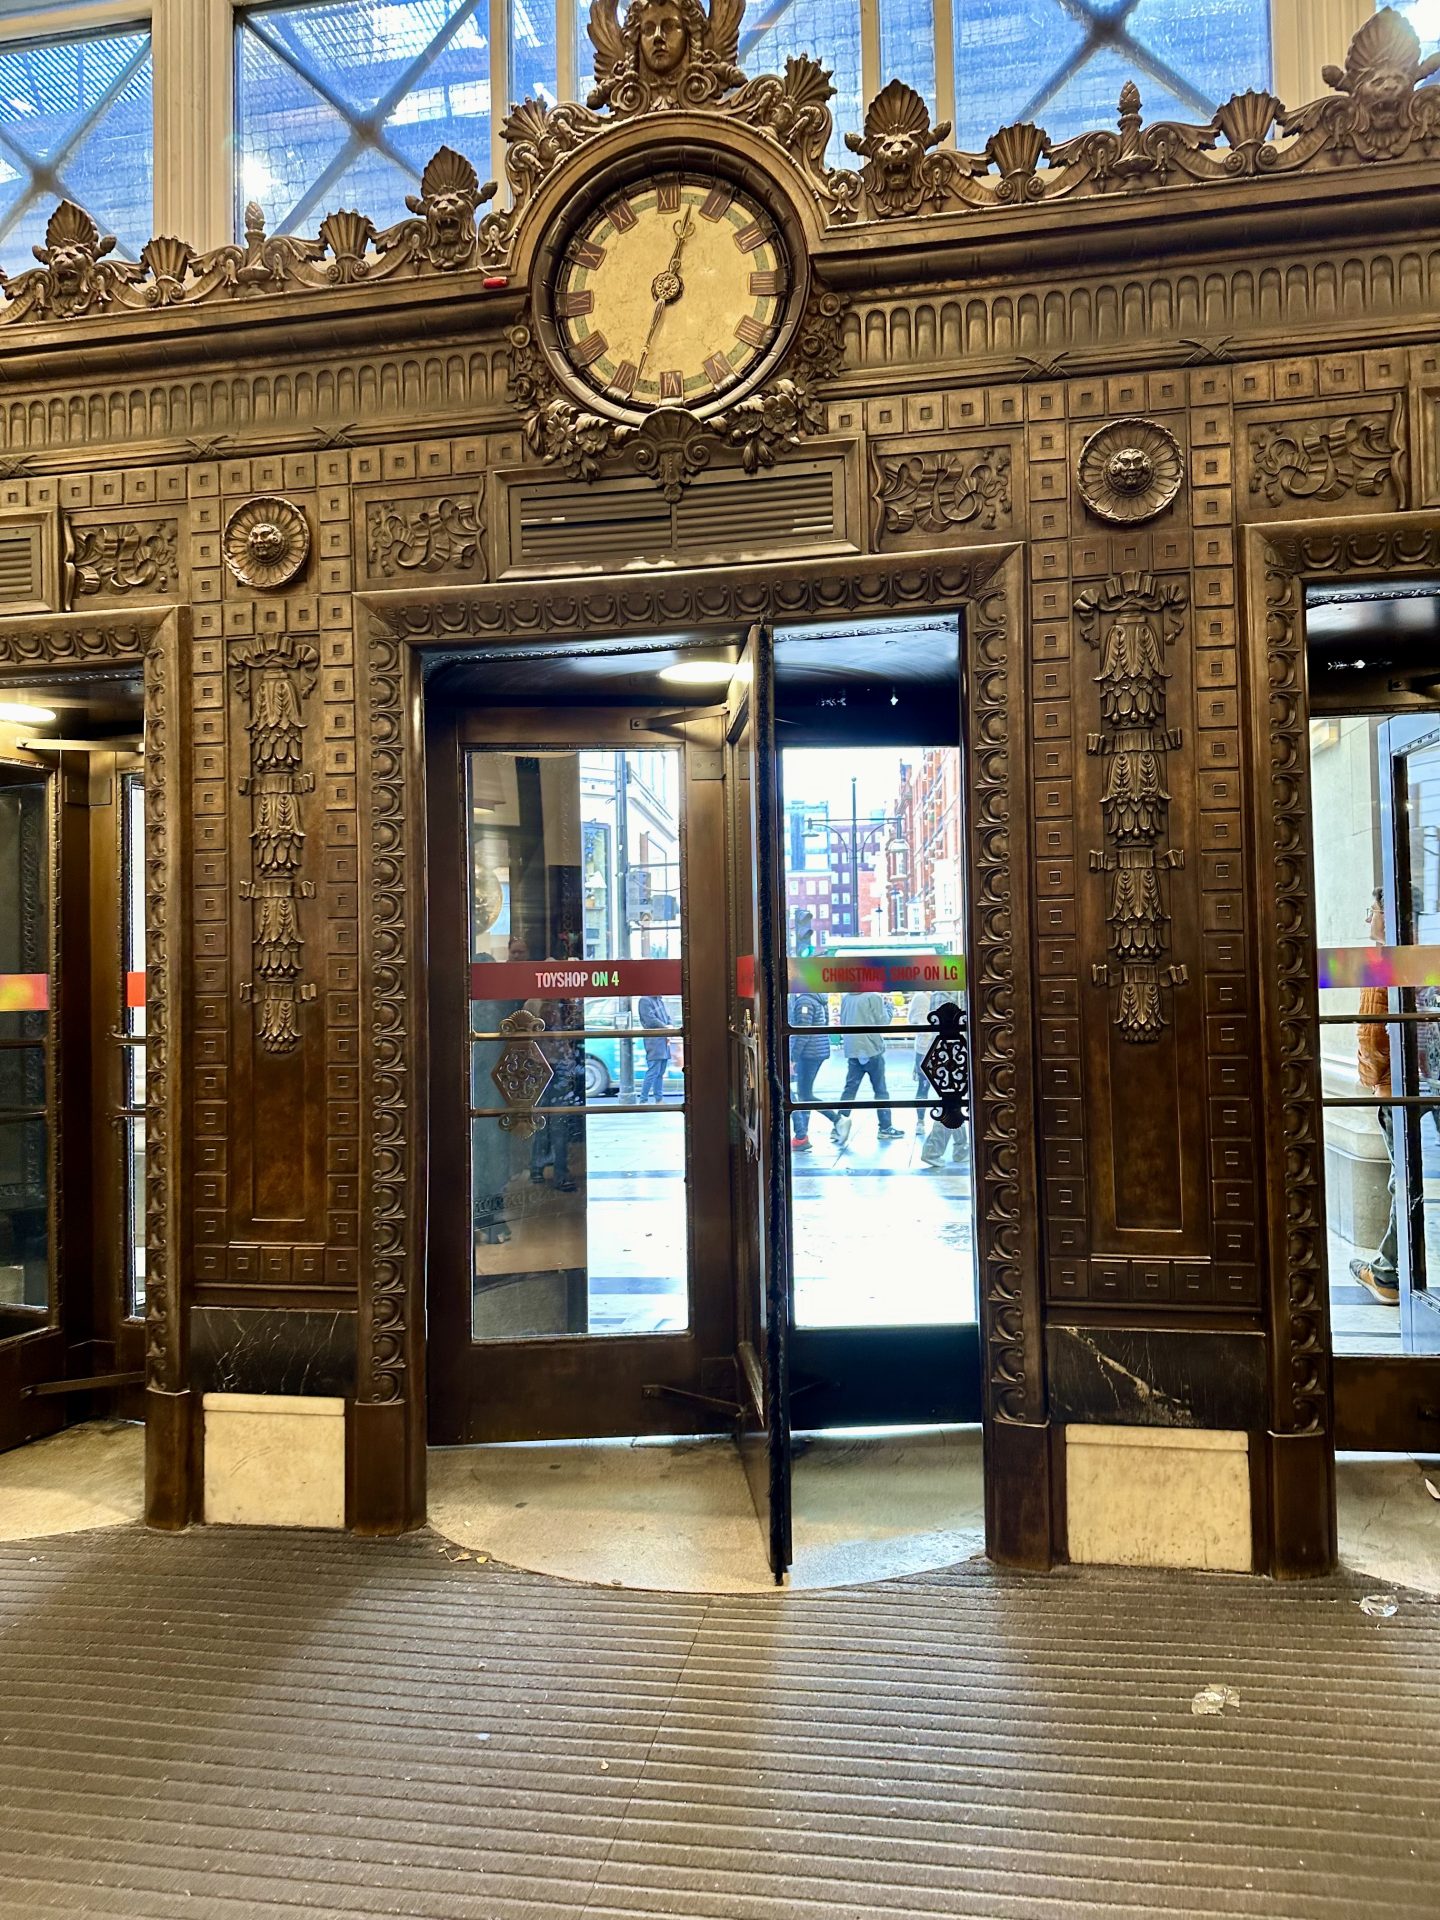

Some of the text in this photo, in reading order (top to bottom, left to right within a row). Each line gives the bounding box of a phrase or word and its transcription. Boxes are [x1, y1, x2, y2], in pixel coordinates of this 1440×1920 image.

[659, 188, 678, 209] XII
[709, 195, 721, 213] I
[612, 204, 633, 226] XI
[740, 229, 760, 244] II
[579, 247, 600, 263] X
[570, 293, 590, 310] IX
[614, 364, 635, 390] VII
[712, 358, 728, 380] V
[664, 373, 680, 396] VI
[535, 971, 620, 988] TOYSHOP ON 4
[822, 965, 958, 982] CHRISTMAS SHOP ON LG
